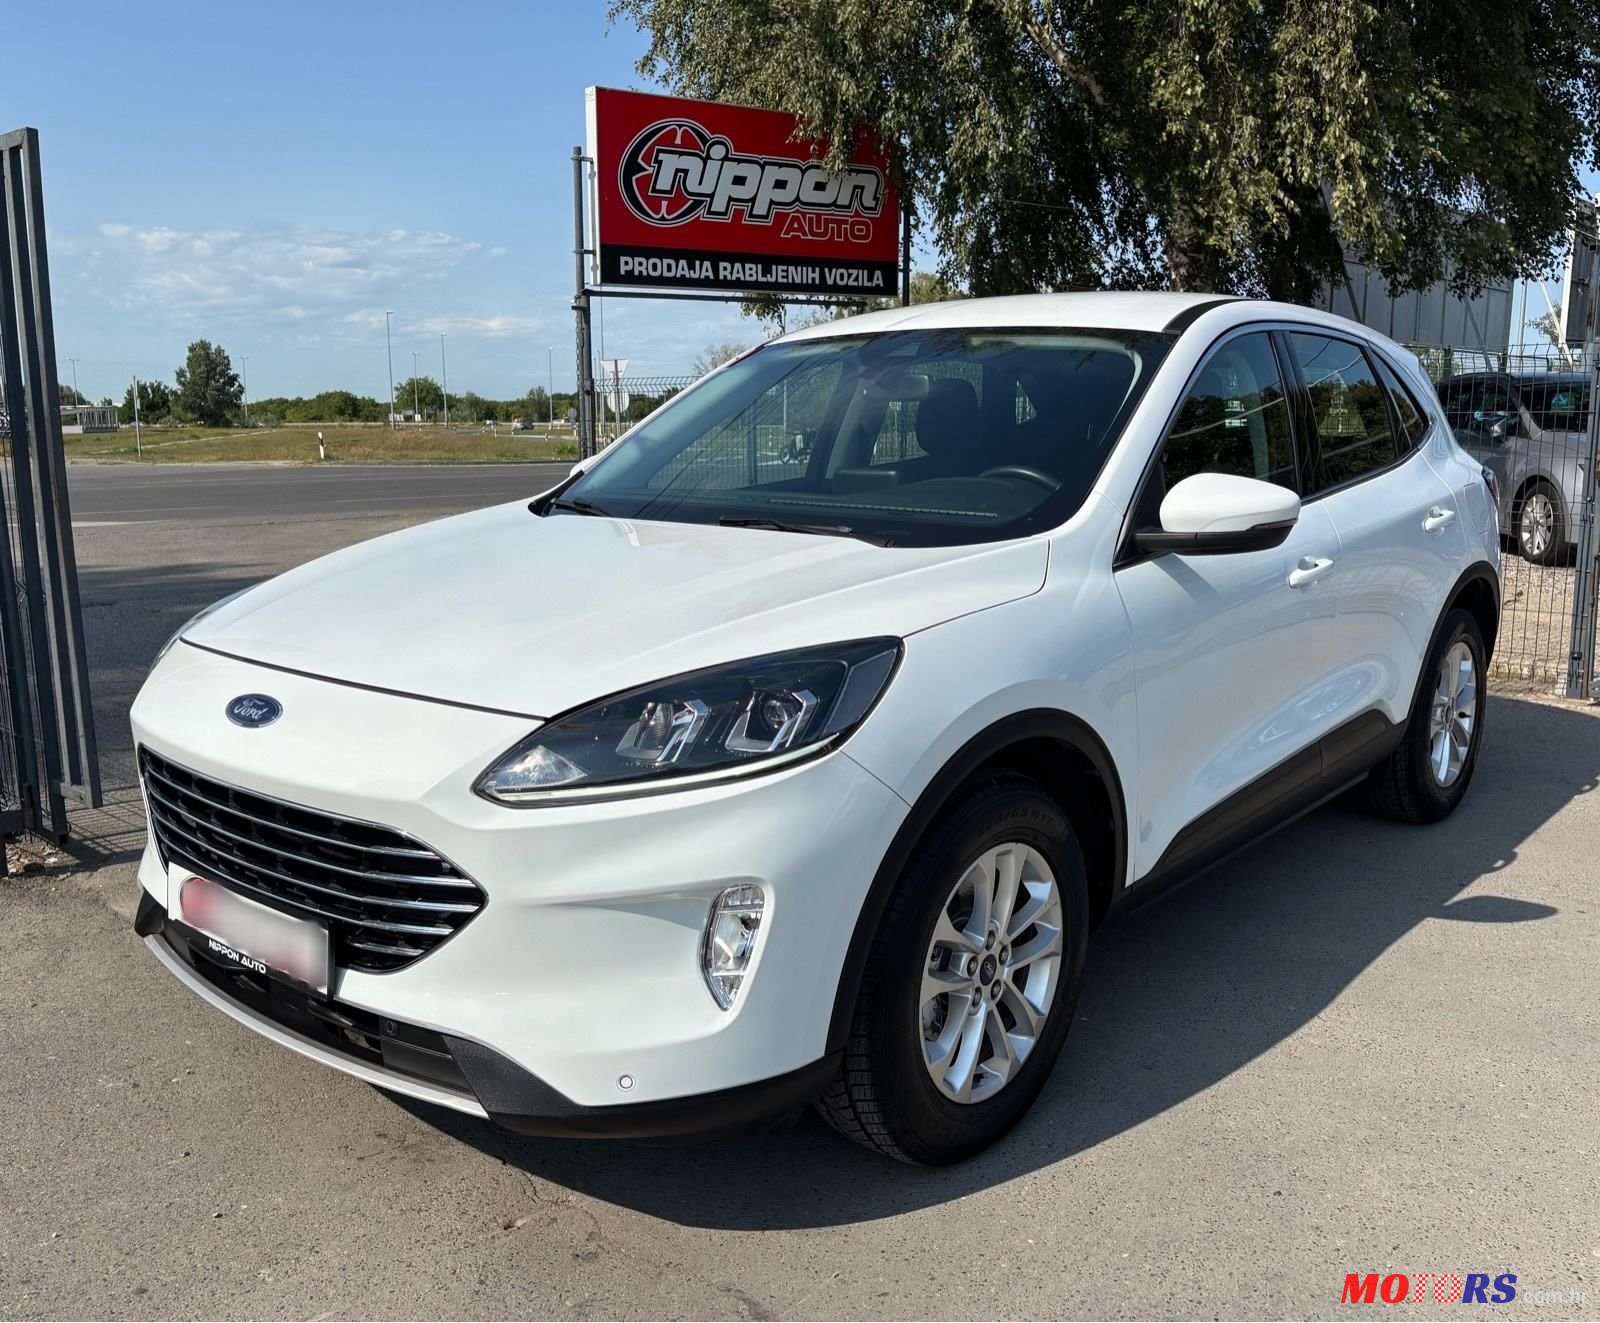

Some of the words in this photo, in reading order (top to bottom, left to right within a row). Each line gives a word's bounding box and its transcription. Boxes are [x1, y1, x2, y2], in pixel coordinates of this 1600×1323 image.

[652, 139, 882, 219] nippon
[781, 214, 872, 242] AUTO
[620, 256, 714, 281] PRODAJA
[719, 262, 820, 284] RABLJENIH
[824, 268, 884, 287] VOZILA
[233, 697, 269, 720] Ford
[208, 938, 240, 962] NIPPON
[241, 956, 267, 975] AUTO
